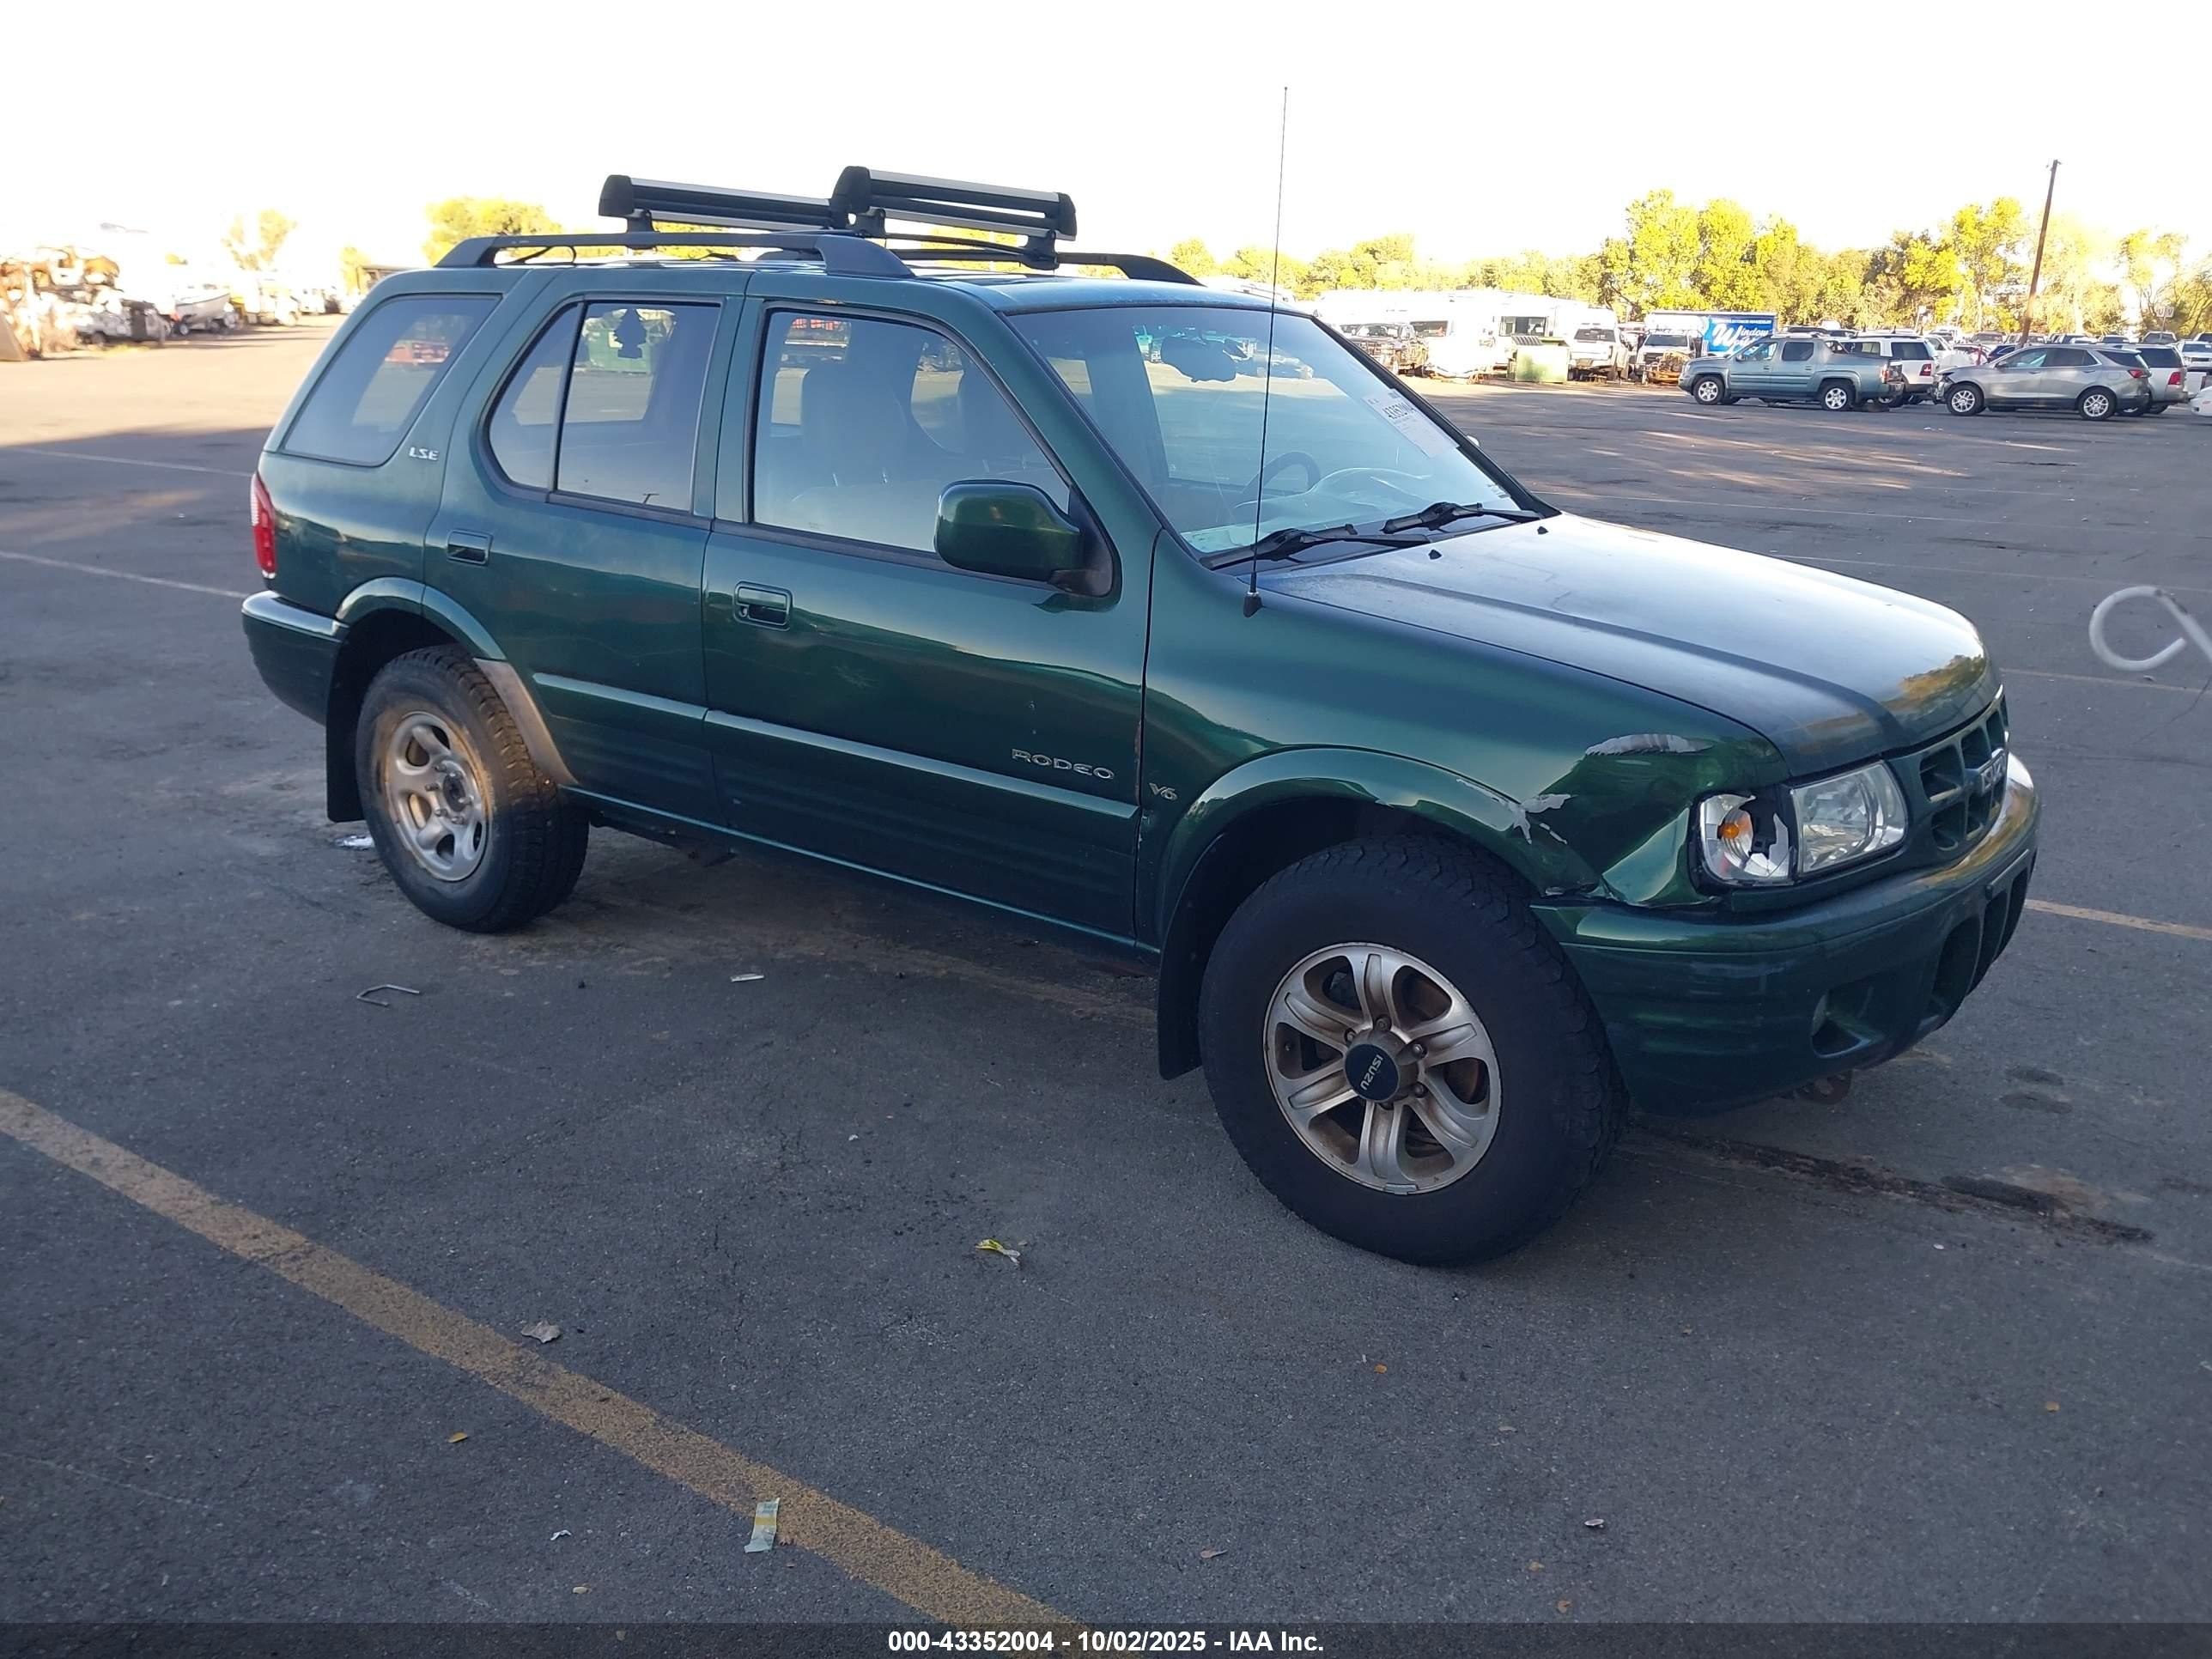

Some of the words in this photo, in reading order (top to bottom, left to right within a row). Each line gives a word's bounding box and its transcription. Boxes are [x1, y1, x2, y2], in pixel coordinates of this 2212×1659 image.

[1712, 323, 1770, 346] Window
[408, 446, 440, 461] LSE
[1011, 748, 1115, 780] RODEO
[1148, 782, 1178, 801] V6
[1359, 1054, 1384, 1091] ISUZU
